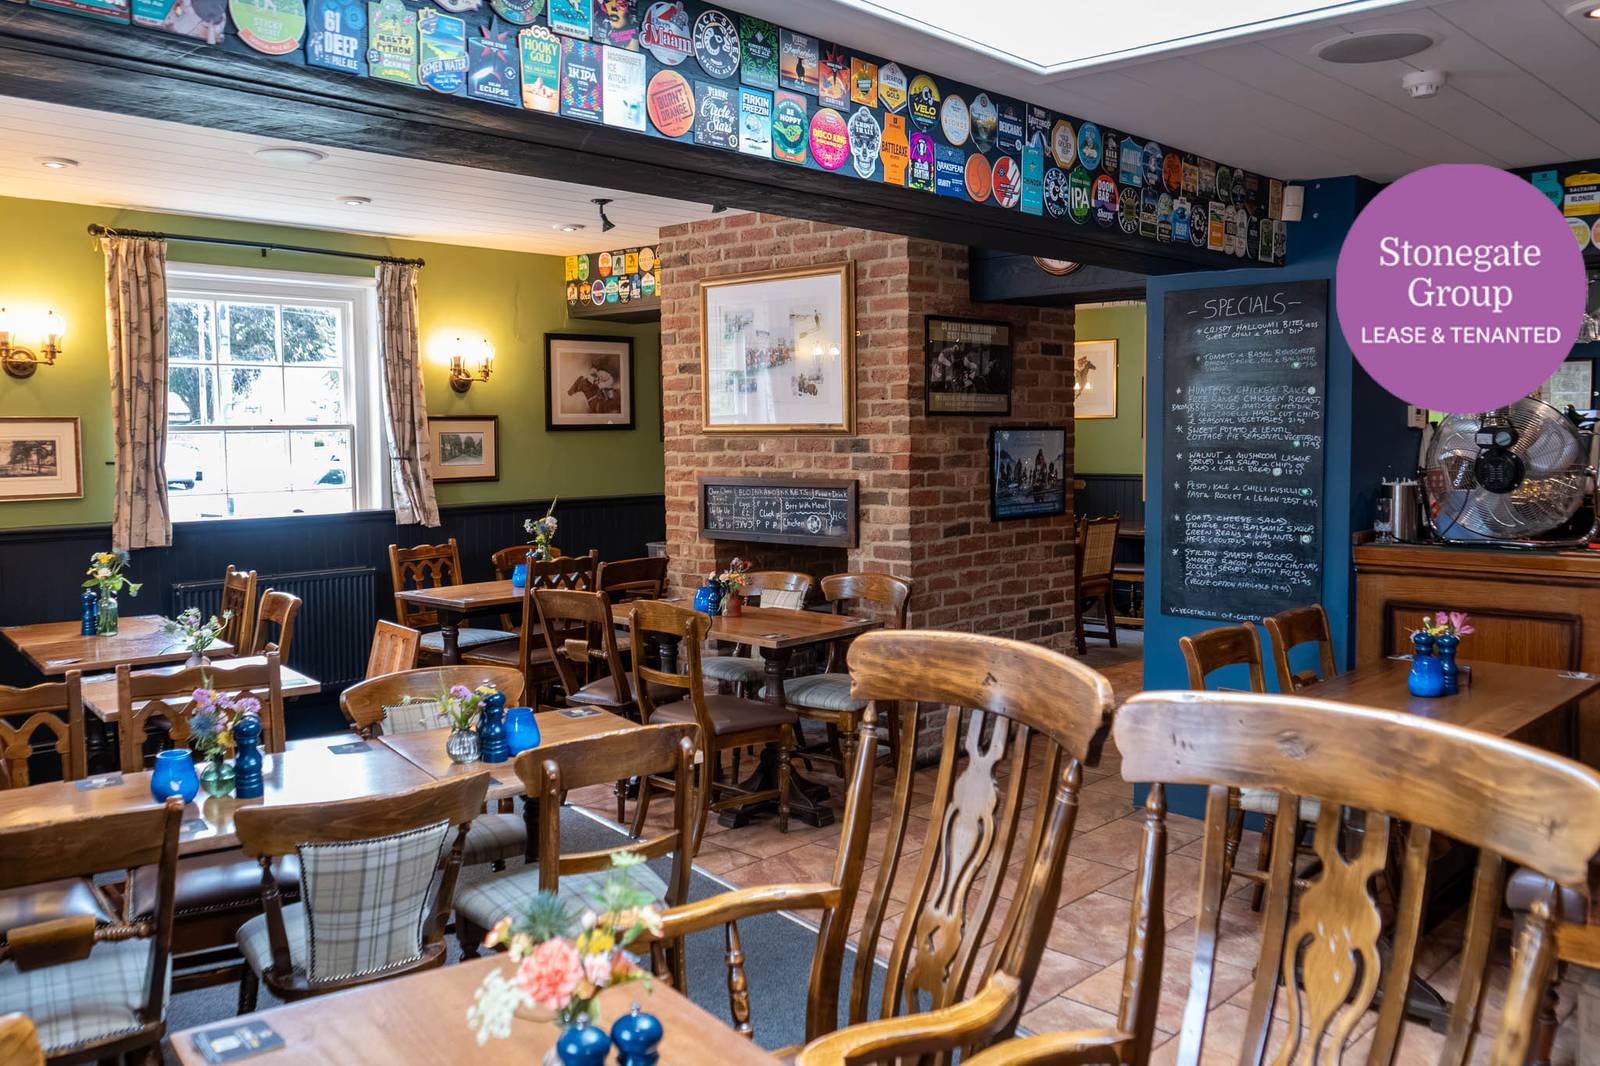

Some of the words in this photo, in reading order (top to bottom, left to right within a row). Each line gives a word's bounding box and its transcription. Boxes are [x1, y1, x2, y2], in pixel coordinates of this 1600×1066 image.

[324, 10, 341, 32] 61
[323, 31, 358, 58] DEEP
[696, 14, 716, 49] BLACK
[721, 18, 739, 64] SHEEP
[524, 38, 558, 56] HOOKY
[530, 52, 552, 64] GOLD
[444, 58, 466, 70] WATER
[479, 85, 509, 96] ECLIPSE
[887, 91, 900, 99] GOLD
[656, 89, 683, 108] BURNT
[742, 92, 769, 108] FIRKIN
[660, 103, 688, 121] ORANGE
[913, 103, 936, 115] VELO
[779, 114, 802, 125] HOPPY
[1097, 180, 1114, 192] DOOM
[1071, 187, 1090, 208] IPA
[1097, 191, 1110, 202] BAR
[1203, 325, 1232, 335] CRISPY
[1236, 322, 1279, 332] HALLOUMI
[1289, 327, 1304, 335] DIP
[1203, 352, 1237, 361] TOMATO
[1236, 386, 1276, 394] CHICKEN
[1237, 416, 1284, 424] VEGETABLES
[1296, 411, 1320, 419] CHIPS
[1186, 433, 1223, 441] COTTAGE
[1189, 451, 1223, 459] WALNUT
[1236, 452, 1277, 460] MUSHROOM
[1270, 461, 1293, 469] CHIPS
[1214, 492, 1242, 500] ROCKET
[1253, 494, 1279, 503] LEMON
[1185, 514, 1213, 522] GOATS
[1216, 515, 1253, 523] CHEESE
[1243, 524, 1284, 532] BALSAMIC
[1215, 530, 1242, 538] BEANS
[1184, 549, 1218, 557] STILTON
[1223, 551, 1253, 559] SMASH
[1255, 560, 1282, 568] ONION
[1196, 570, 1218, 578] SLAW
[1280, 569, 1308, 578] FRIES
